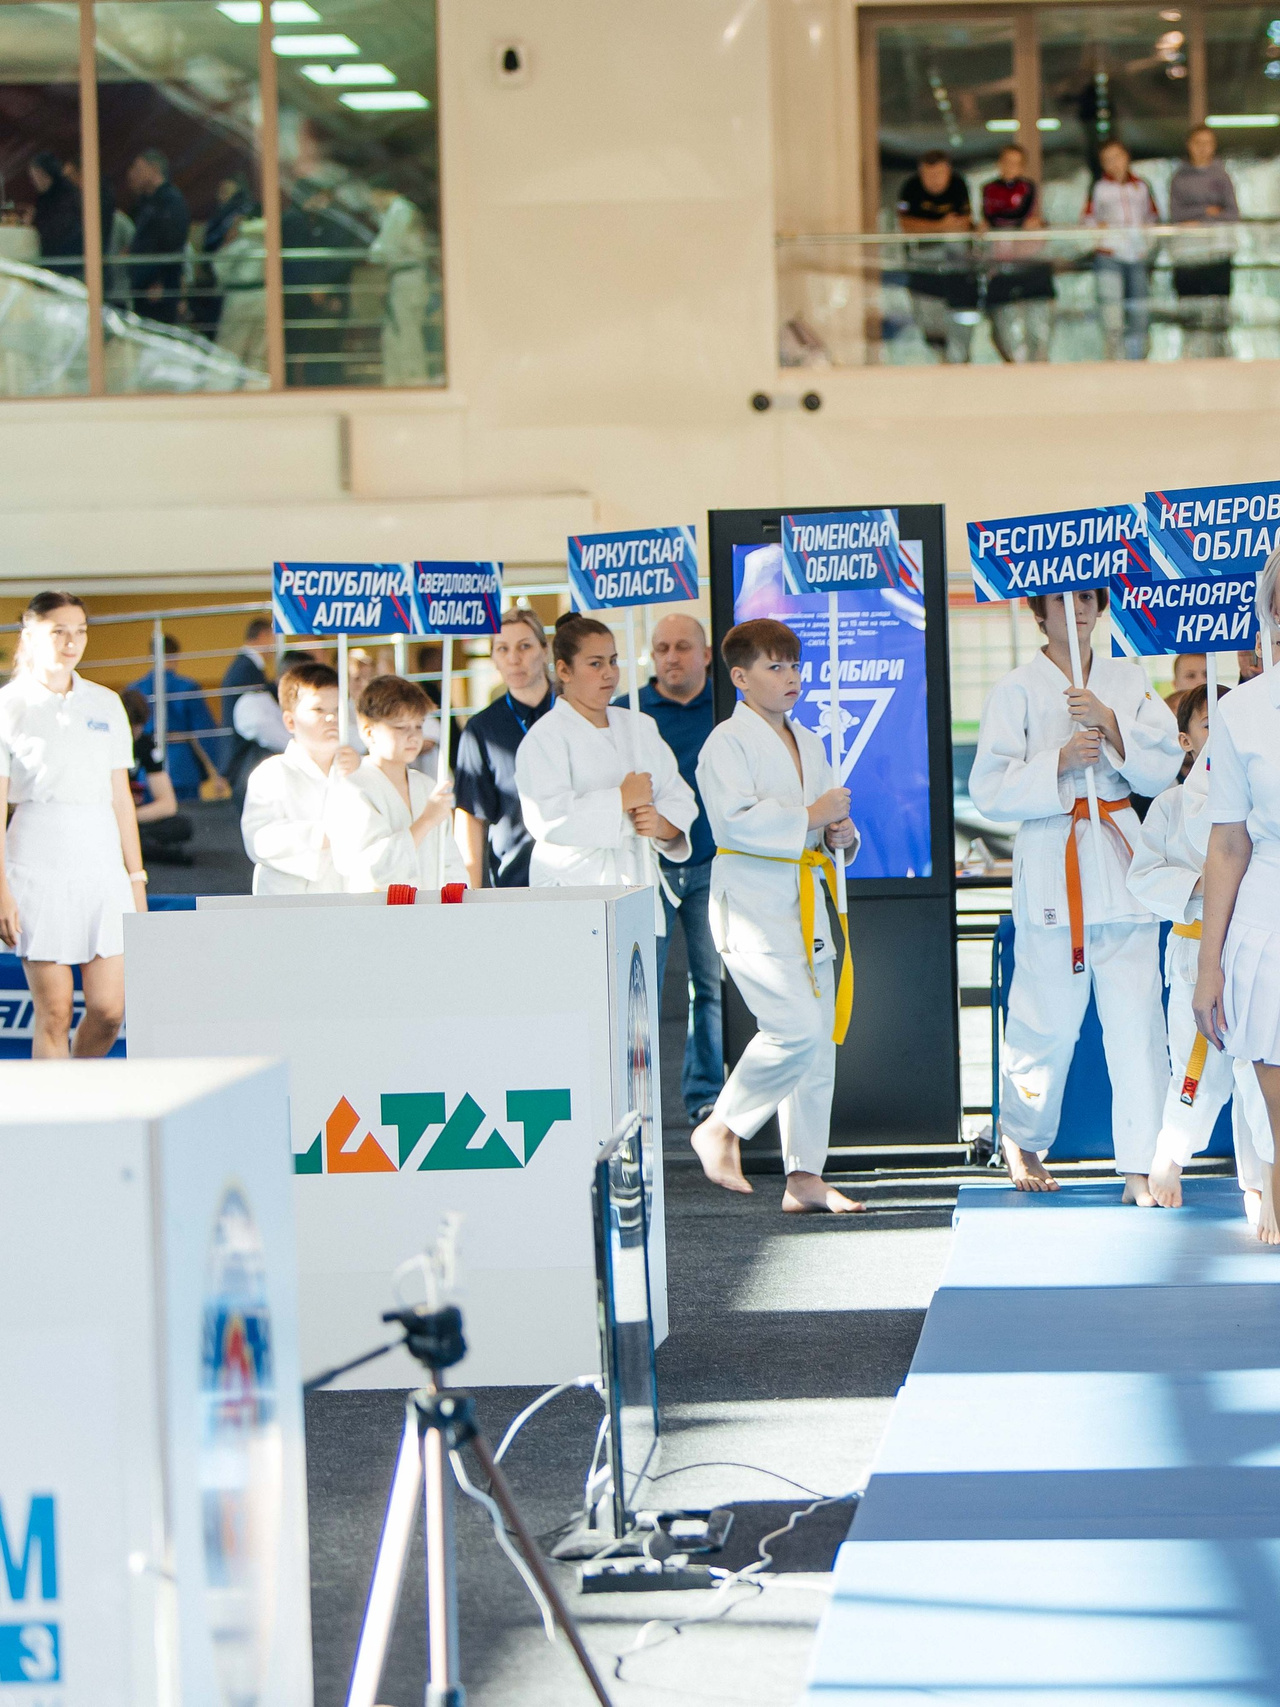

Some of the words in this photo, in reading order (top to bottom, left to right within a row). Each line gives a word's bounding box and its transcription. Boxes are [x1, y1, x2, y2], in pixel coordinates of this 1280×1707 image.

[791, 520, 890, 553] ТЮМЕНСКАЯ
[978, 511, 1149, 559] РЕСПУБЛИКА
[581, 535, 685, 571] ИРКУТСКАЯ
[805, 553, 878, 584] ОБЛАСТЬ
[279, 570, 412, 597] РЕСПУБЛИКА
[417, 572, 497, 595] СВЕРДЛОВСКАЯ
[594, 568, 675, 600] ОБЛАСТЬ
[1007, 548, 1128, 591] ХАКАСИЯ
[1121, 581, 1257, 610] КРАСНОЯРС
[312, 596, 382, 628] АЛТАЙ
[428, 600, 486, 626] ОБЛАСТЬ
[1175, 604, 1252, 643] КРАЙ
